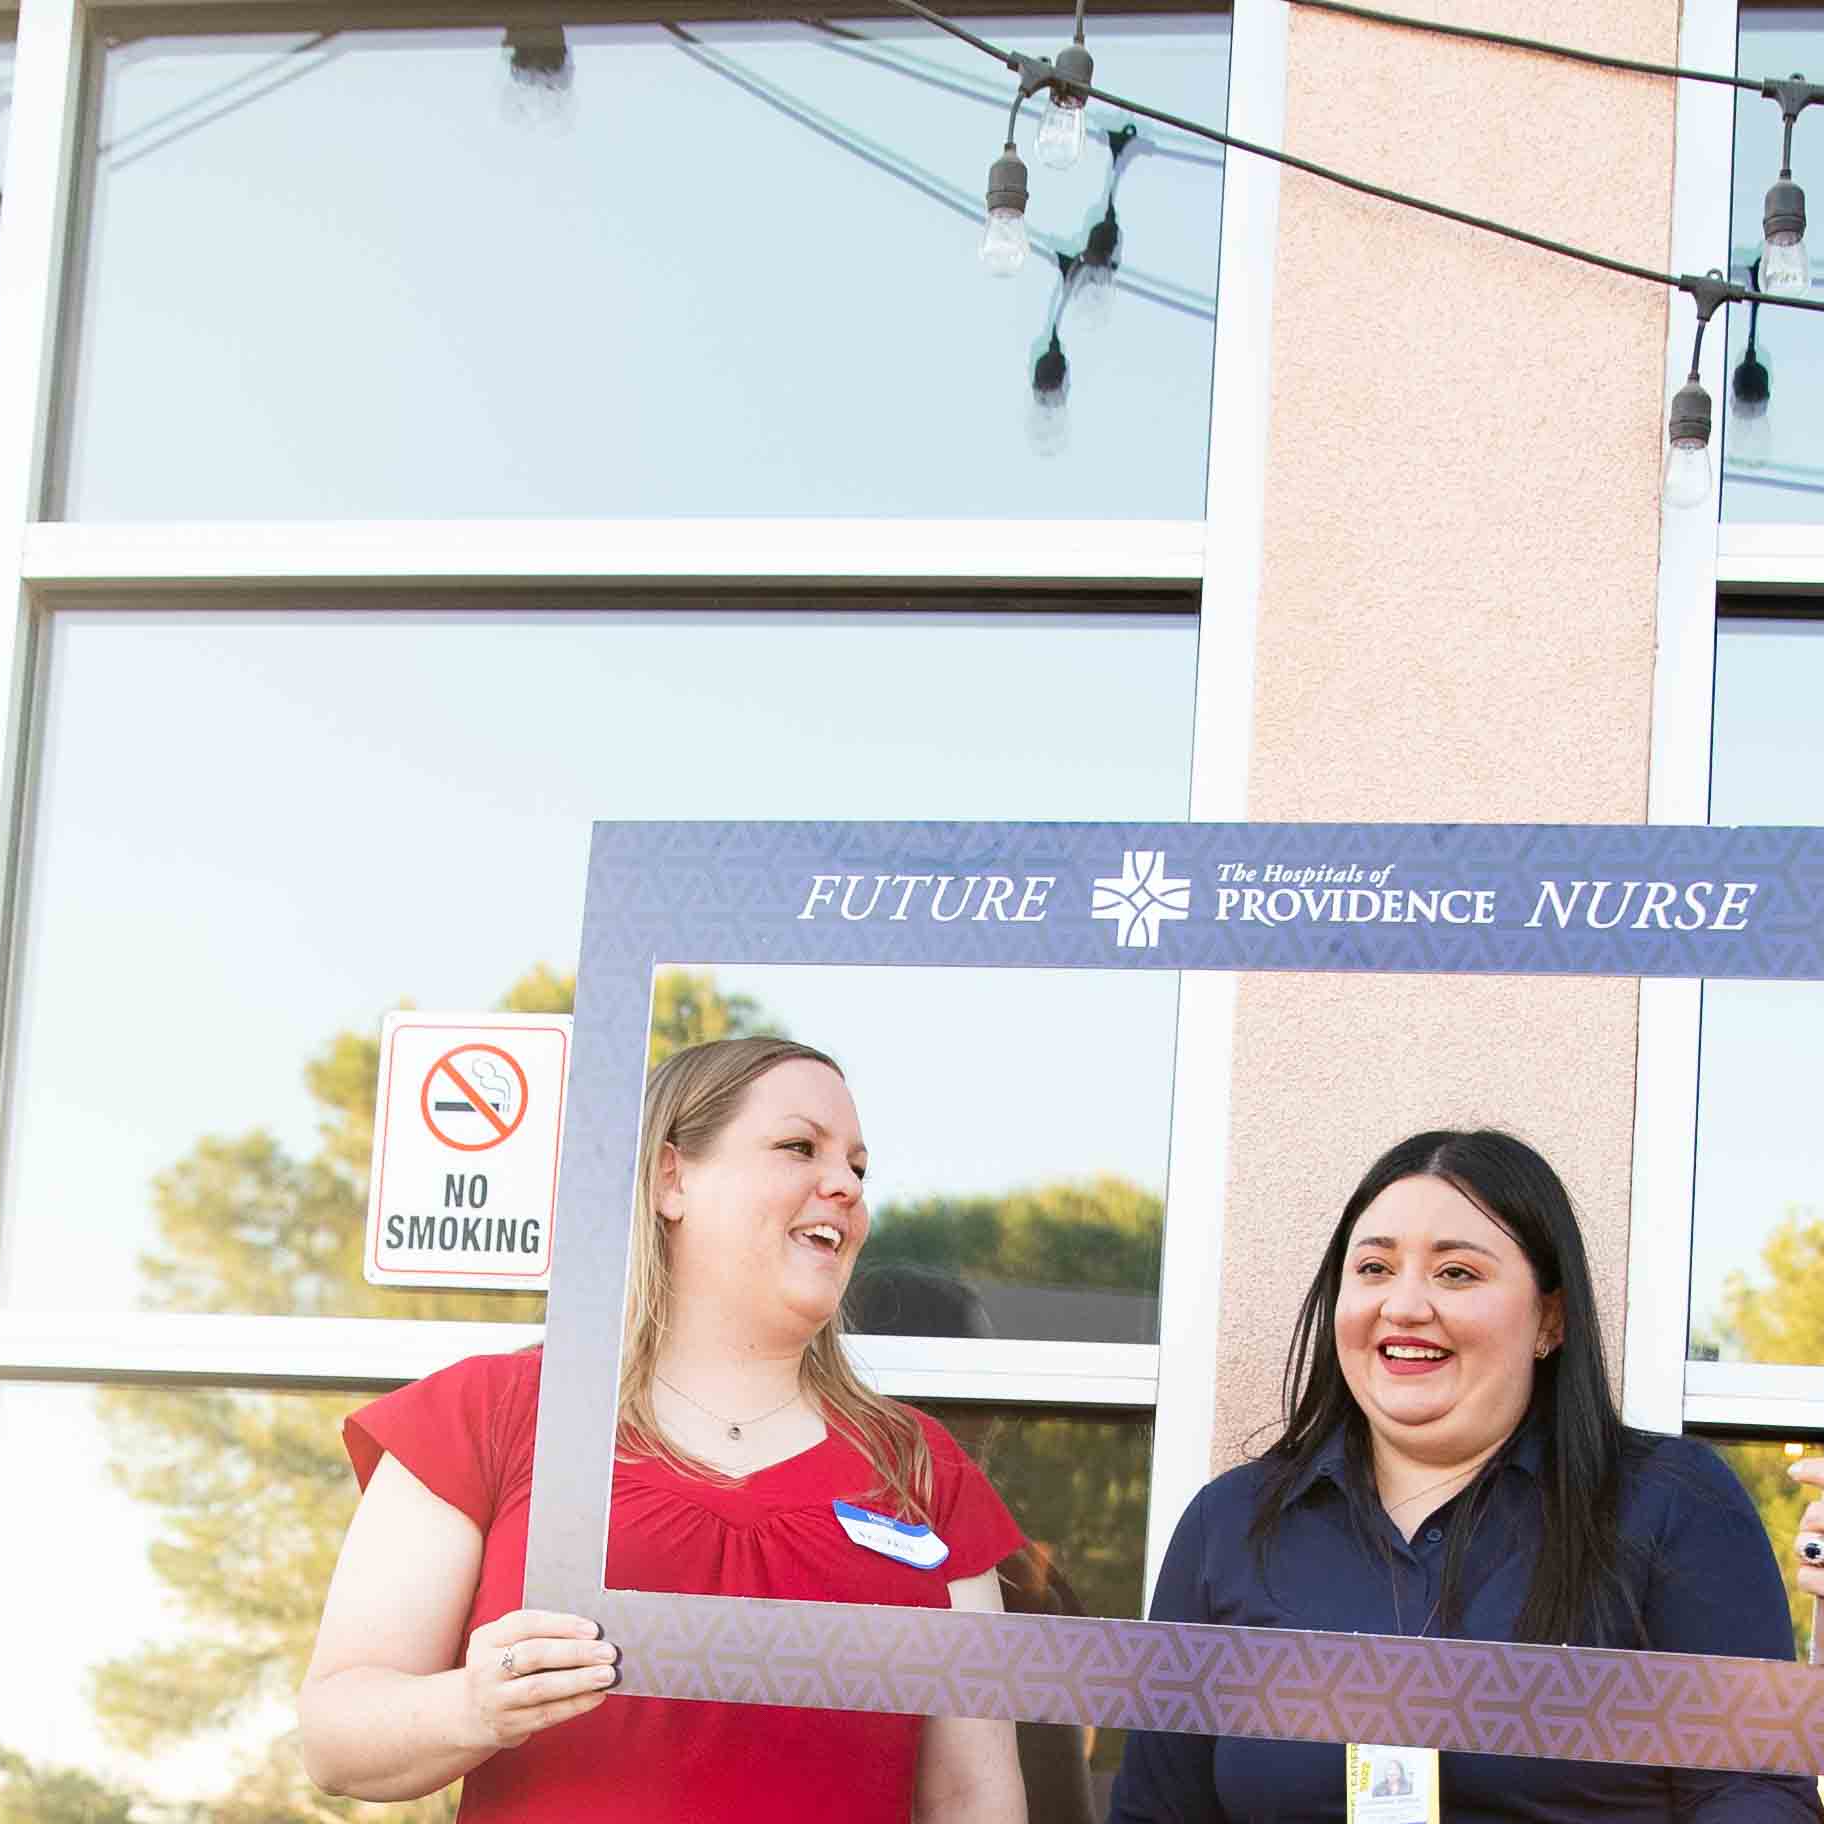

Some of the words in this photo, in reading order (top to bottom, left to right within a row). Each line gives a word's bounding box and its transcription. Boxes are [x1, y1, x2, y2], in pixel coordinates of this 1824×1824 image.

[1216, 863, 1257, 883] The
[1263, 863, 1364, 888] Hospitals
[1368, 863, 1396, 888] of
[796, 874, 1057, 922] FUTURE
[1215, 888, 1496, 927] PROVIDENCE
[1523, 880, 1759, 931] NURSE
[443, 1173, 489, 1209] NO
[385, 1214, 541, 1254] SMOKING
